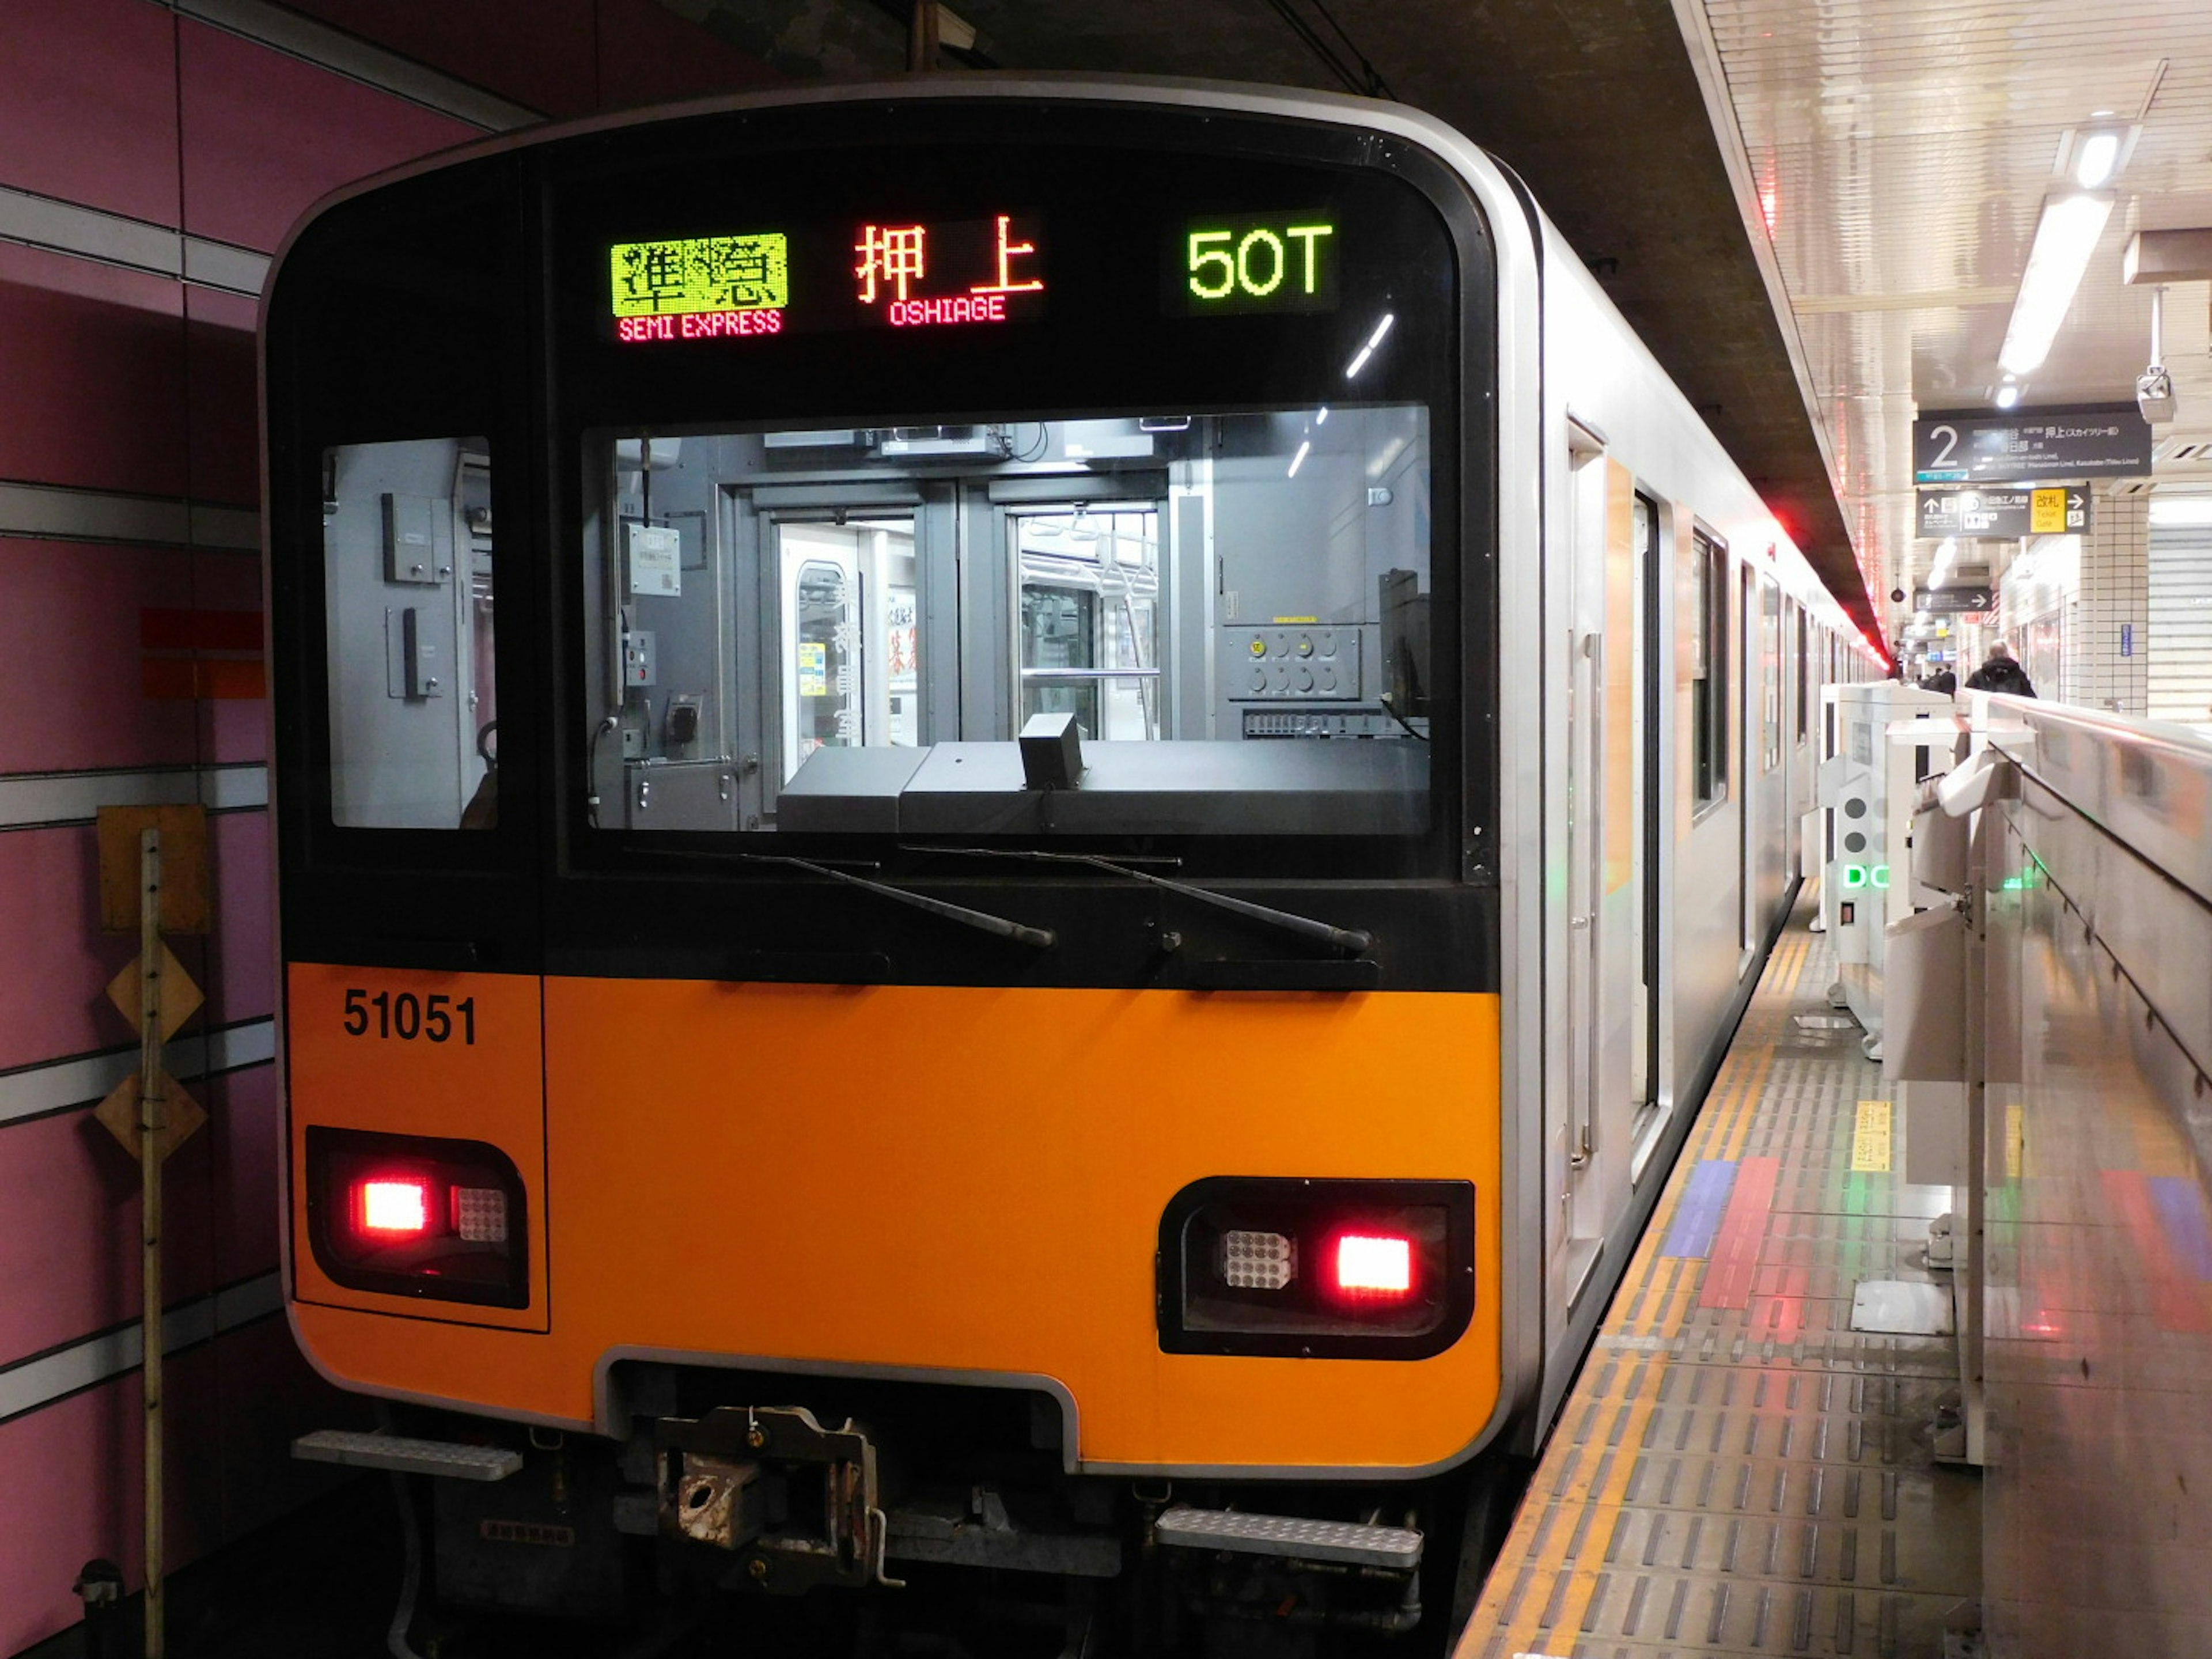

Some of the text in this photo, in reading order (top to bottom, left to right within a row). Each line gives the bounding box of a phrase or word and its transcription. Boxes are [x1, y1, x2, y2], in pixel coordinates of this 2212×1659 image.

[621, 237, 778, 312] 準急
[1189, 225, 1333, 299] 50T
[619, 309, 781, 342] SEMI EXPRESS
[890, 296, 1005, 325] OSHIAGE
[1930, 425, 1958, 468] 2
[2036, 495, 2059, 507] 改札
[344, 988, 475, 1045] 51051
